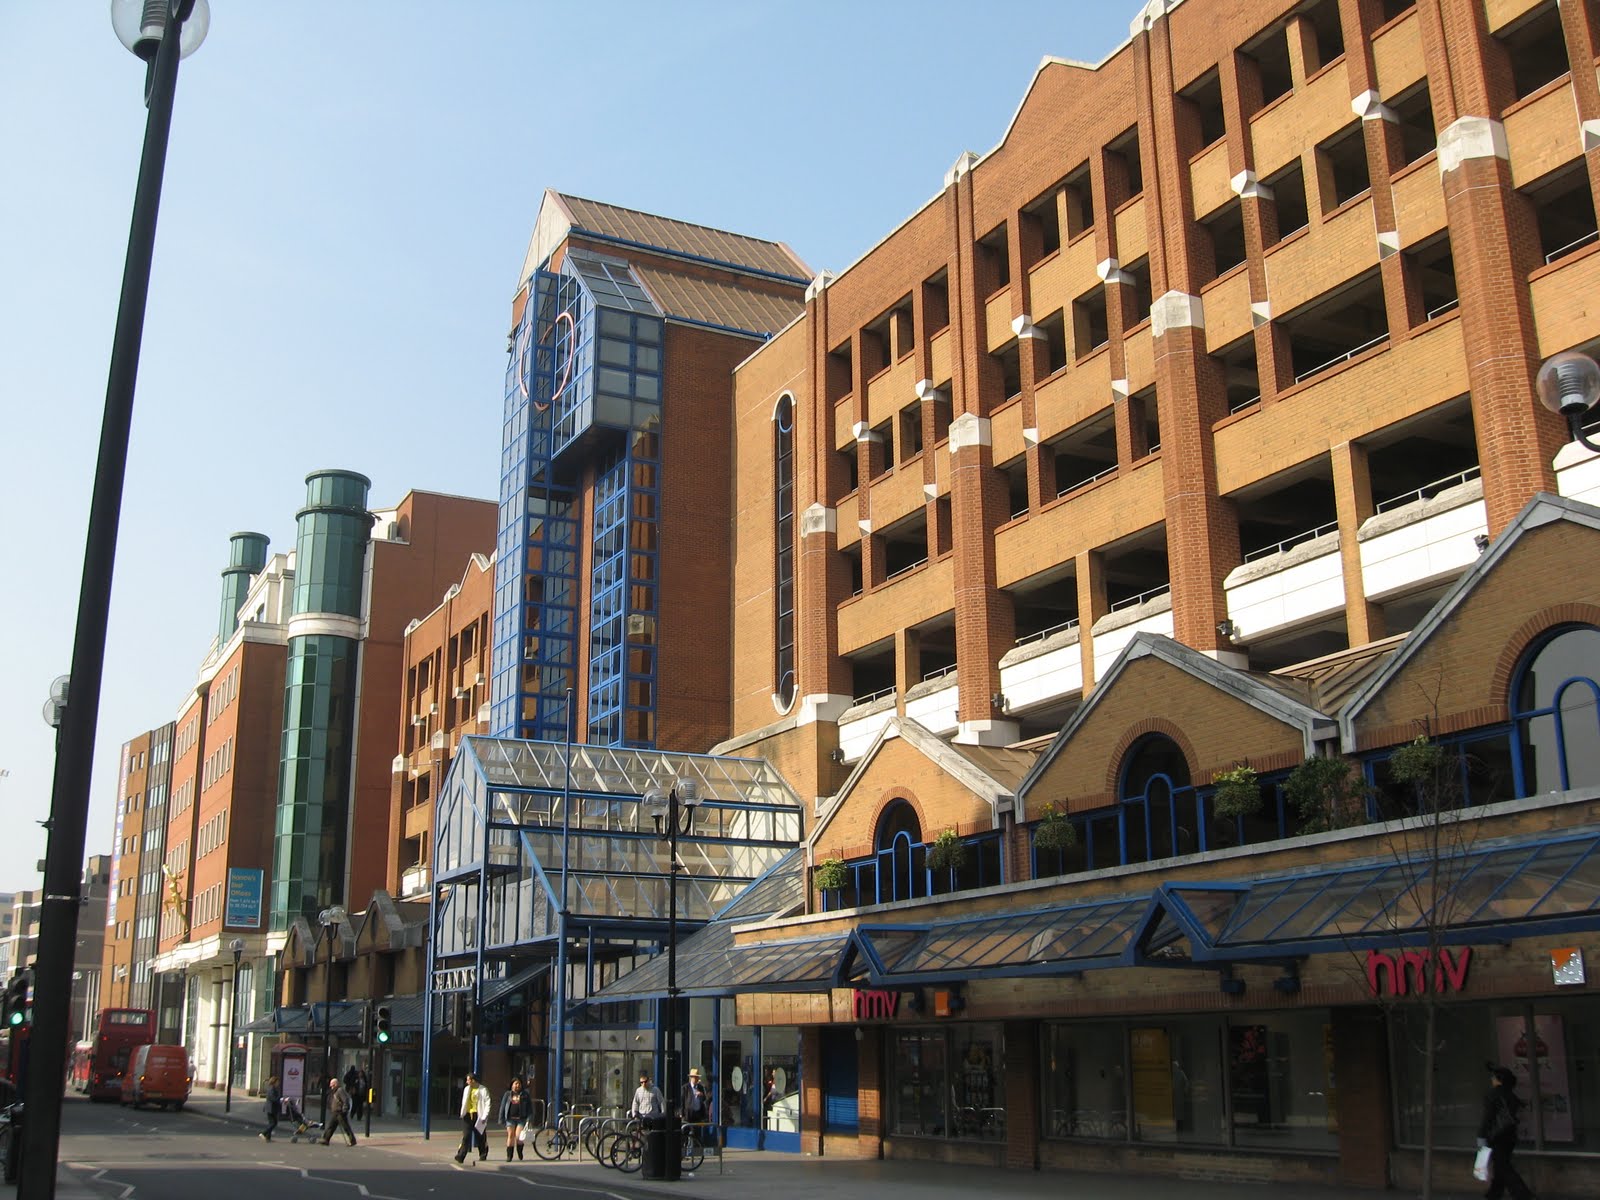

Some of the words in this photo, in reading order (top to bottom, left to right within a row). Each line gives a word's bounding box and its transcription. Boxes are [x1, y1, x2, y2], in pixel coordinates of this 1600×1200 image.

[117, 804, 125, 823] TO
[1367, 947, 1472, 996] hmv
[853, 987, 898, 1019] hmv
